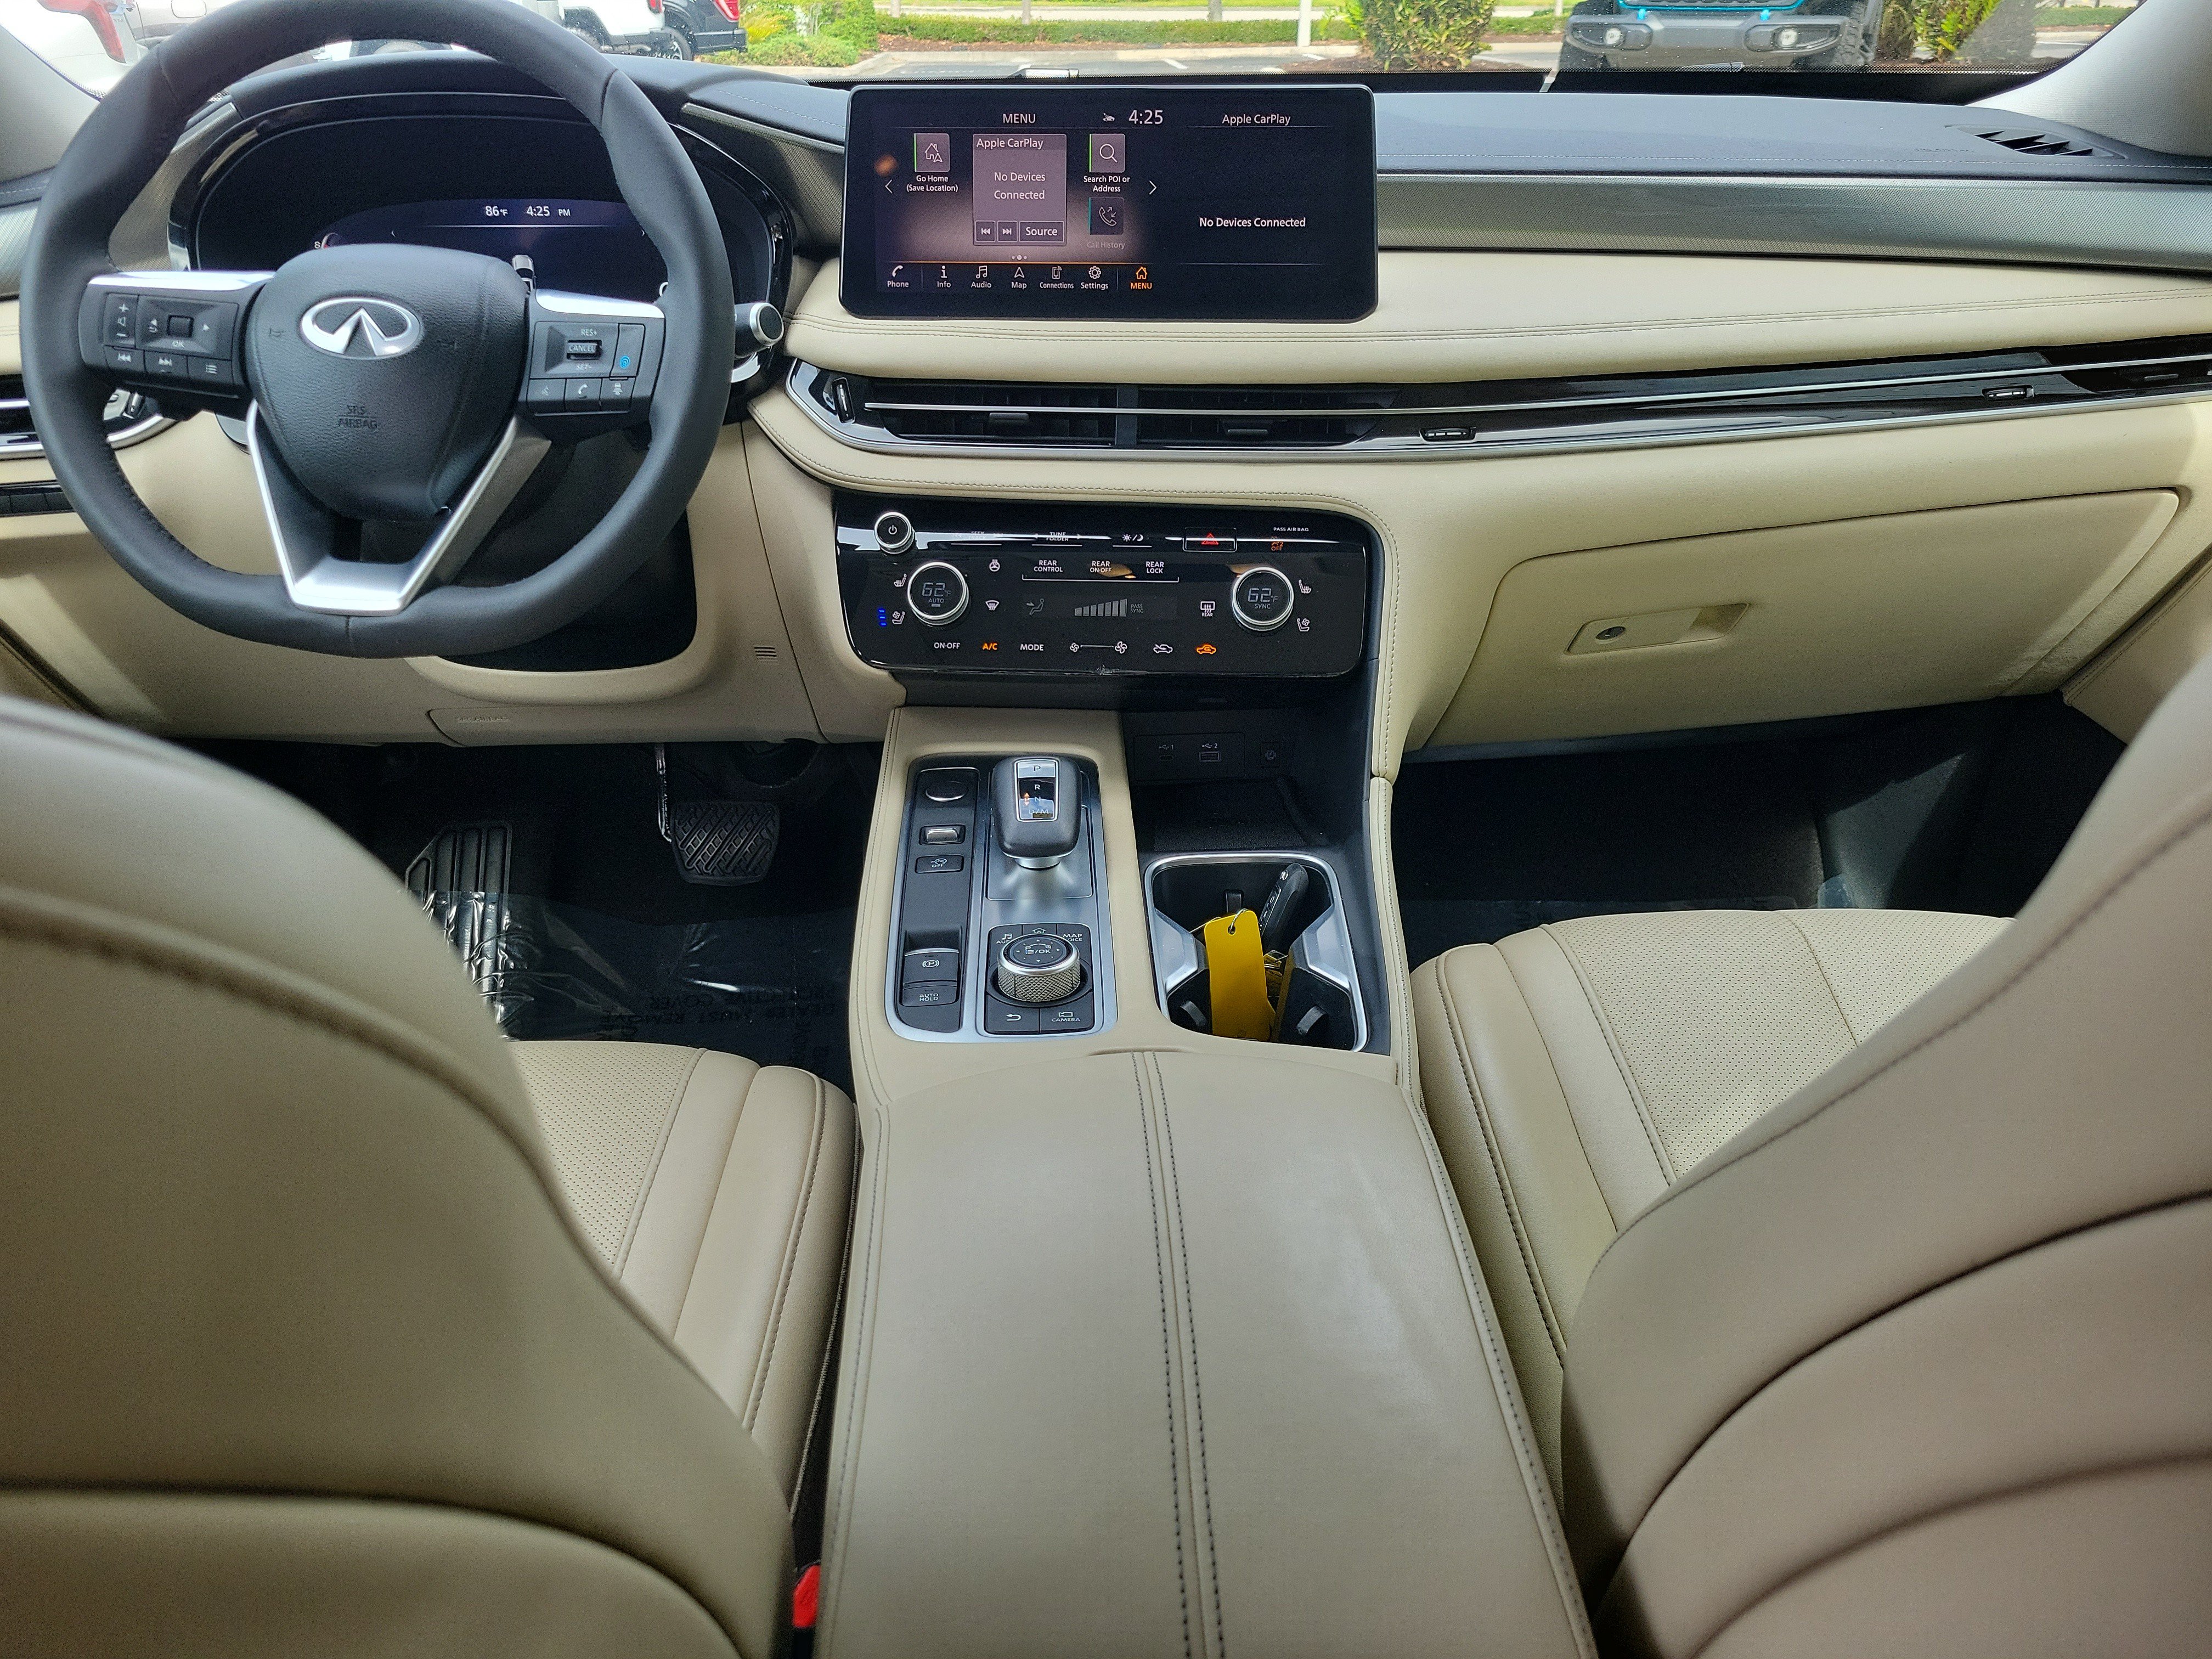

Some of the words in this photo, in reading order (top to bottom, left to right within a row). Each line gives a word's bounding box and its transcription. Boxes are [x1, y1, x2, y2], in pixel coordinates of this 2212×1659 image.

[1003, 114, 1036, 124] MENU
[1128, 110, 1164, 125] 4:25
[1222, 115, 1251, 126] Apple
[1254, 114, 1290, 126] CarPlay
[976, 138, 1005, 149] Apple
[1007, 138, 1043, 150] CarPlay
[994, 173, 1008, 182] No
[1010, 172, 1046, 182] Devices
[906, 184, 924, 192] (Save
[926, 184, 958, 192] Location)
[1093, 184, 1121, 193] Address
[994, 190, 1045, 200] Connected
[527, 206, 550, 216] 4:25
[1200, 218, 1213, 227] No
[1216, 218, 1251, 227] Devices
[1254, 218, 1306, 227] Connected
[1025, 227, 1058, 236] Source
[1101, 241, 1125, 250] History
[970, 280, 991, 289] Audio
[1011, 281, 1027, 290] Map
[1081, 281, 1108, 290] Settings
